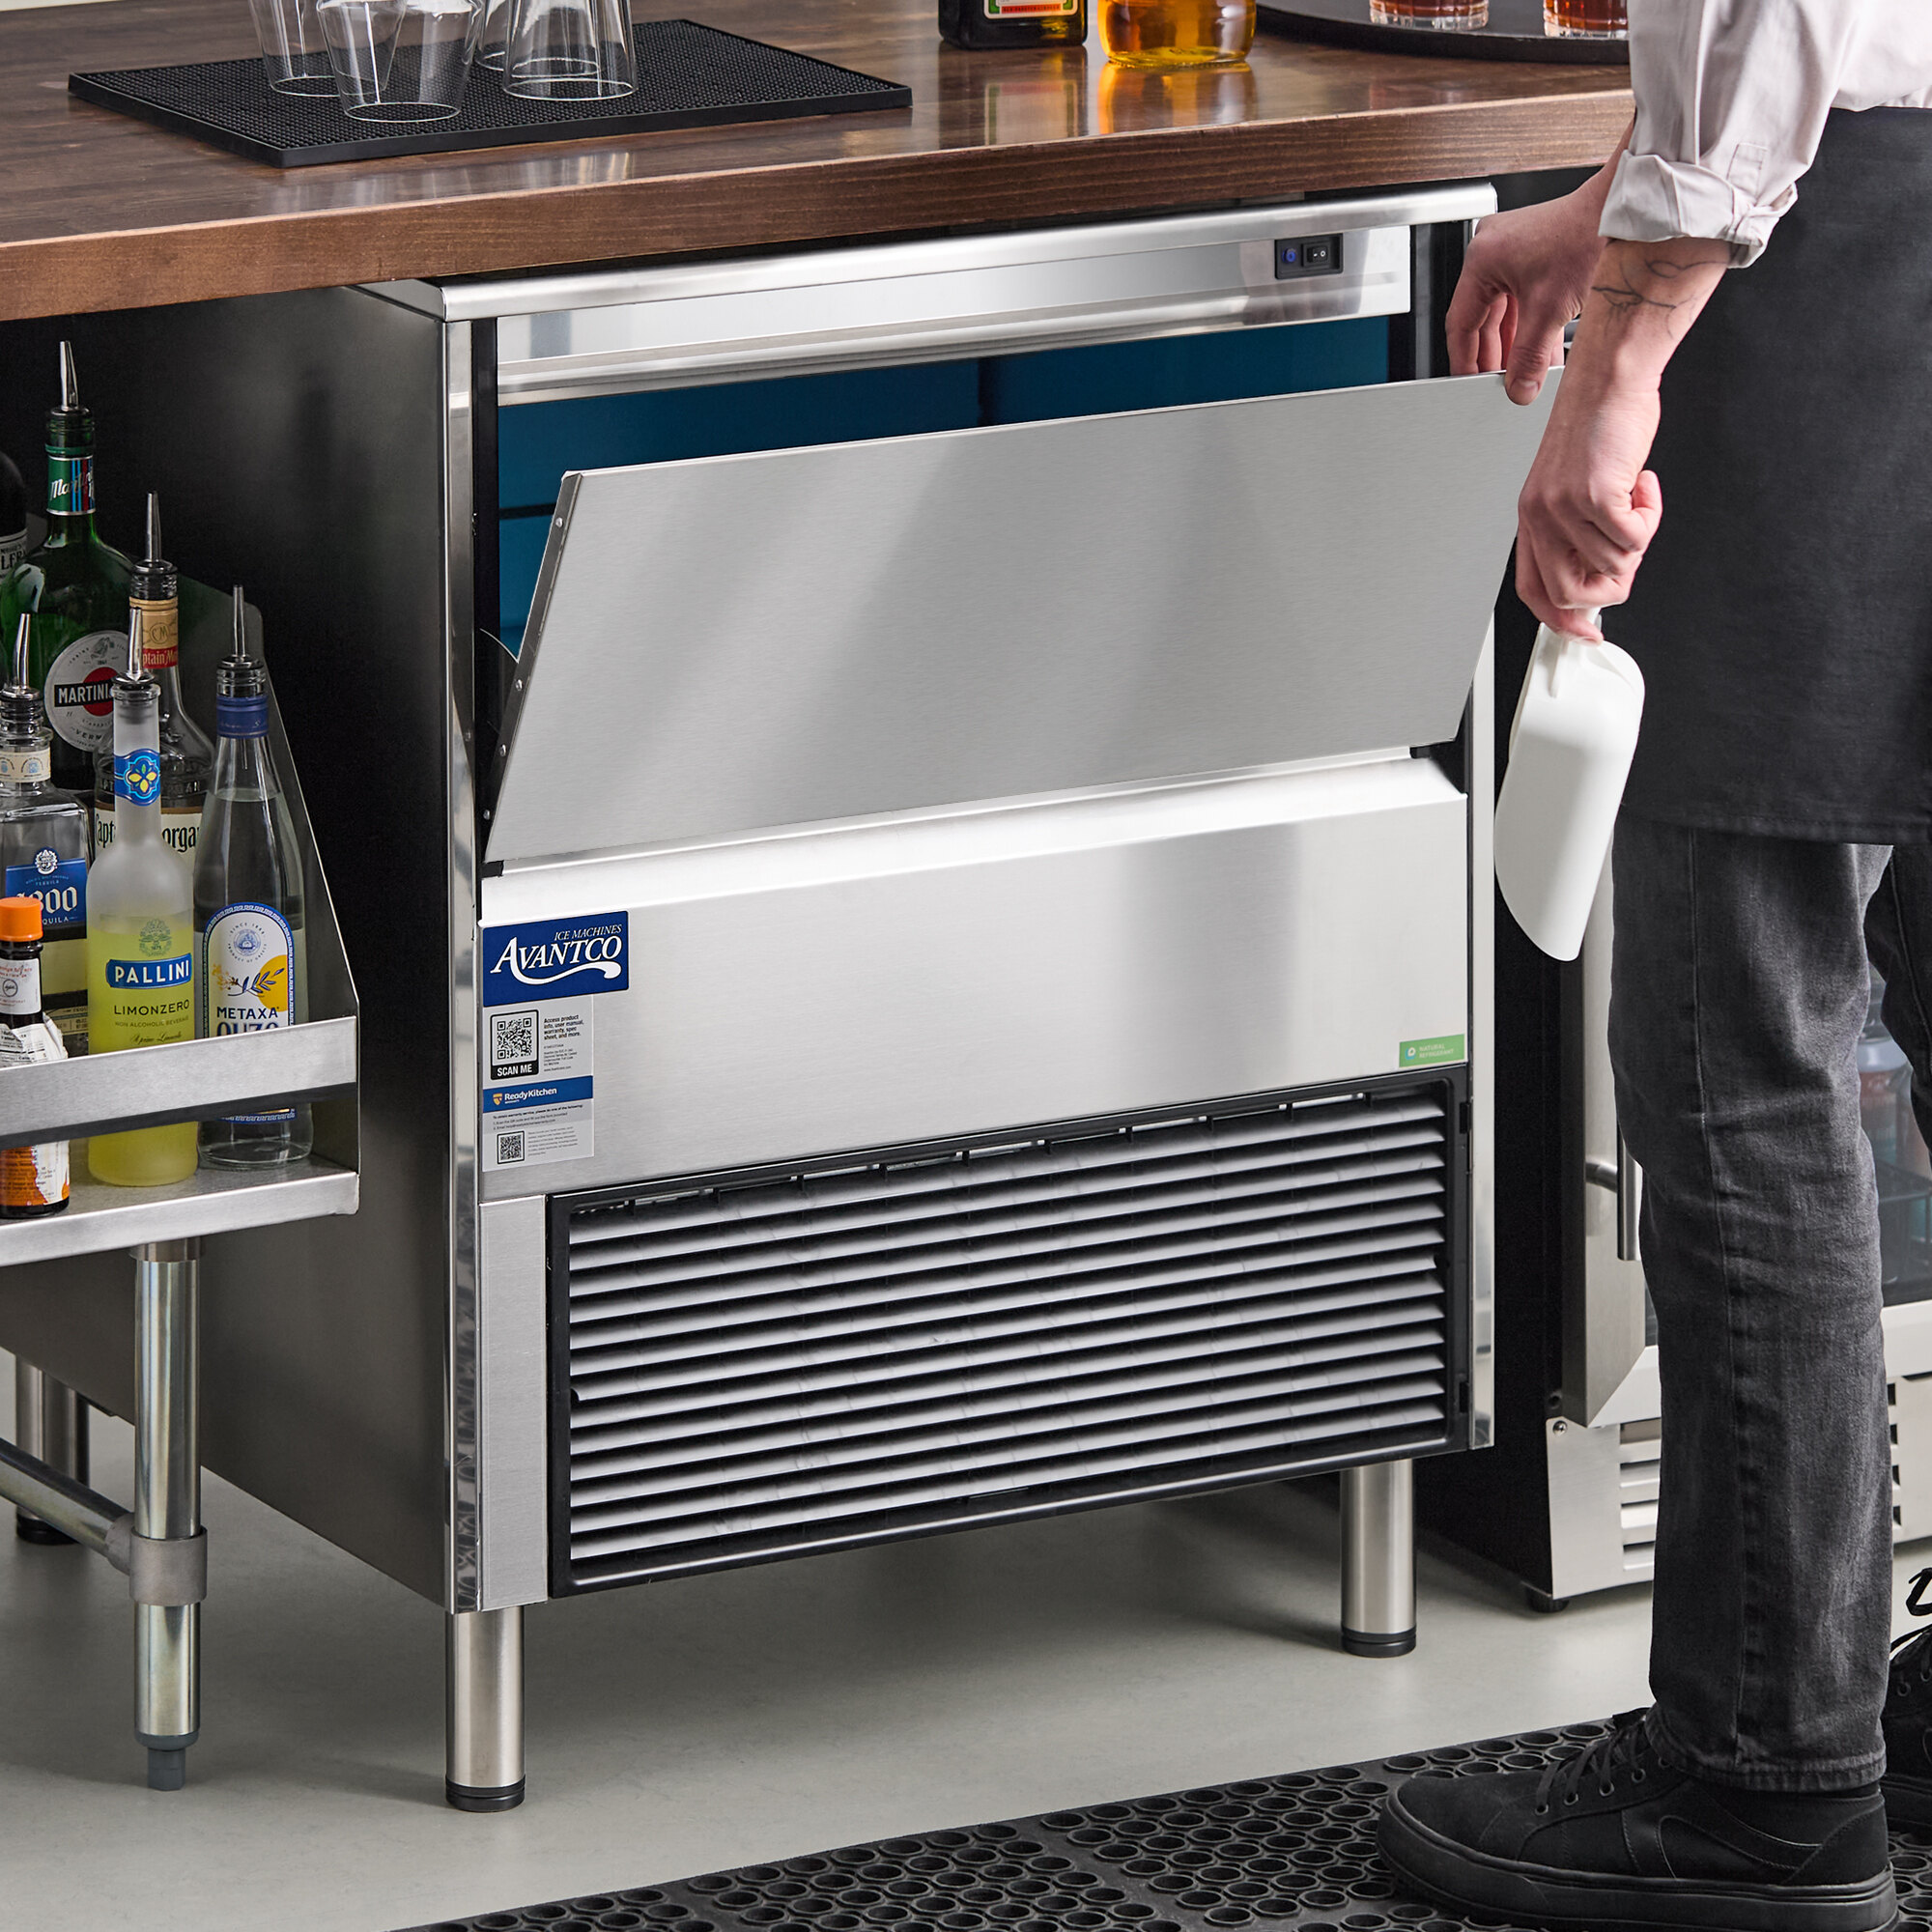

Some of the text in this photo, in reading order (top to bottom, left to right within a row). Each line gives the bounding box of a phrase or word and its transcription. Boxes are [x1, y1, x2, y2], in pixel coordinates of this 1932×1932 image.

[42, 916, 70, 925] QUILA
[554, 923, 622, 942] ICE MACHINES
[115, 959, 189, 983] PALLINI
[114, 999, 190, 1016] LIMONZERO
[216, 1006, 278, 1020] METAXA
[497, 1065, 519, 1077] SCAN
[520, 1064, 533, 1074] ME
